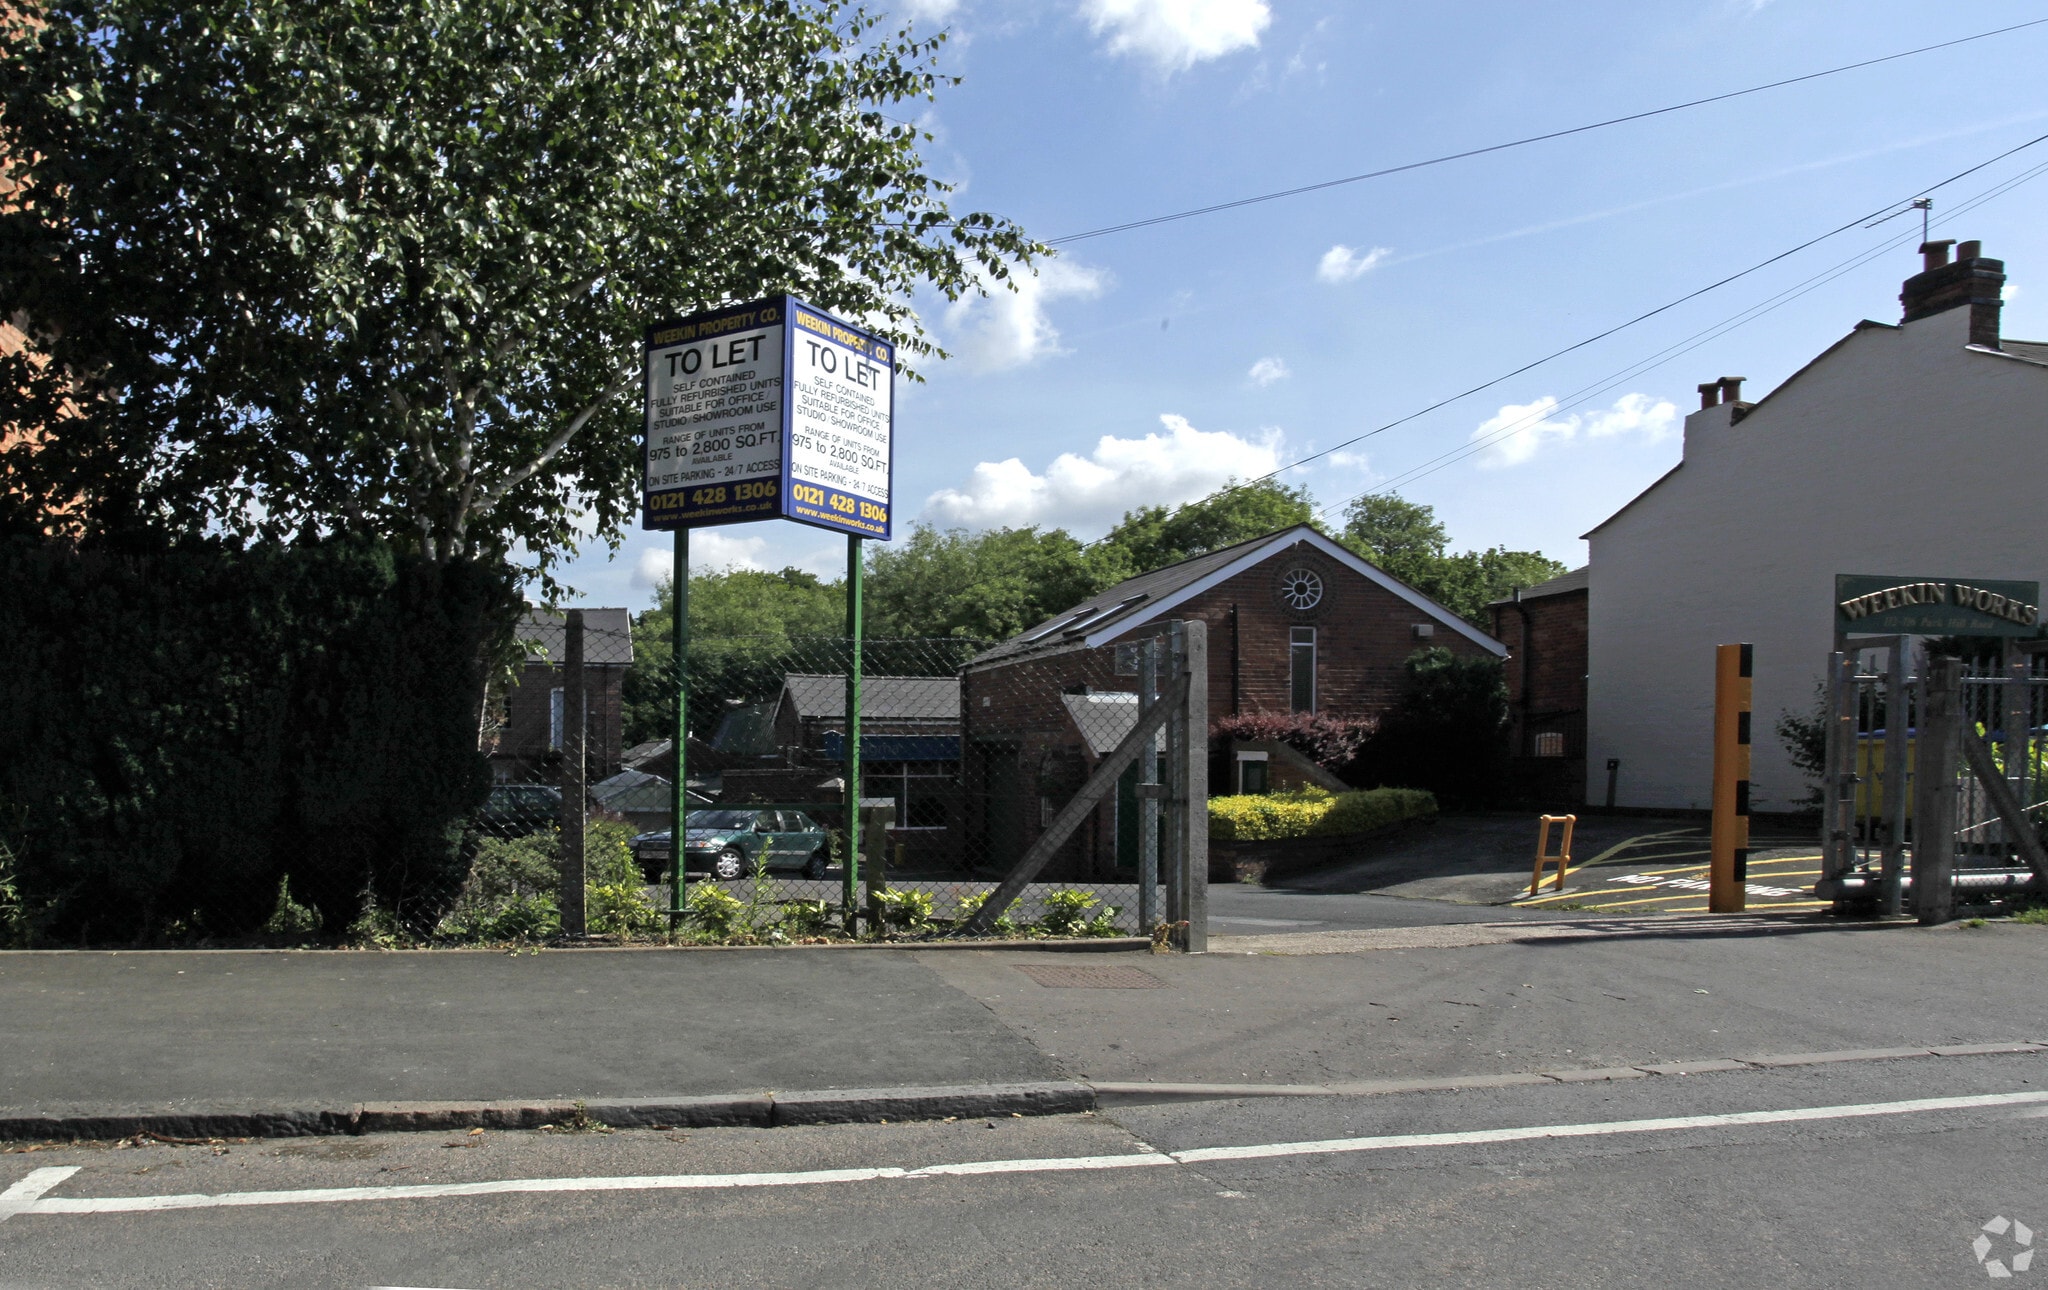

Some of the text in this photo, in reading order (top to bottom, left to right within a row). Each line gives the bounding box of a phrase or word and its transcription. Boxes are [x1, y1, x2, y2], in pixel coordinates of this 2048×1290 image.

[653, 308, 780, 344] WEEKIN PROPERTY CO.
[796, 310, 831, 337] WEEKIN
[876, 346, 889, 362] CO.
[665, 335, 766, 377] TO LET
[806, 340, 881, 391] TO LET
[650, 377, 781, 408] FULLY REFURBISHED UNITS
[673, 370, 756, 393] SELF CONTAINED
[814, 376, 875, 407] SELF CONTAINED
[660, 403, 702, 418] SUITABLE
[705, 398, 725, 409] FOR
[756, 401, 777, 412] USE
[794, 380, 890, 423] FULLY REFURBISHED UNITS
[802, 395, 880, 430] SUITABLE FOR OFFICE
[662, 422, 765, 445] RANGE OF UNITS FROM
[792, 434, 811, 449] 975
[816, 440, 826, 454] to
[830, 445, 858, 463] 2,800
[805, 426, 880, 457] RANGE OF UNITS FROM
[875, 431, 887, 443] USE
[649, 447, 671, 461] 975
[676, 446, 687, 457] to
[692, 438, 730, 455] 2,800
[691, 453, 733, 465] AVAILABLE
[648, 476, 660, 487] ON
[662, 473, 679, 485] SITE
[680, 468, 715, 482] PARKING
[746, 459, 780, 474] ACCESS
[792, 462, 802, 473] ON
[804, 465, 818, 478] SITE
[820, 470, 847, 486] PARKING
[867, 484, 889, 499] ACCESS
[829, 460, 859, 474] AVAILABLE
[650, 480, 777, 510] 0121 428 1306
[793, 484, 887, 523] 0121 428 1306
[796, 506, 885, 534] www.weekinworks.co.uk
[1839, 582, 2038, 626] WEEKIN WORKS
[1606, 874, 1664, 884] NO
